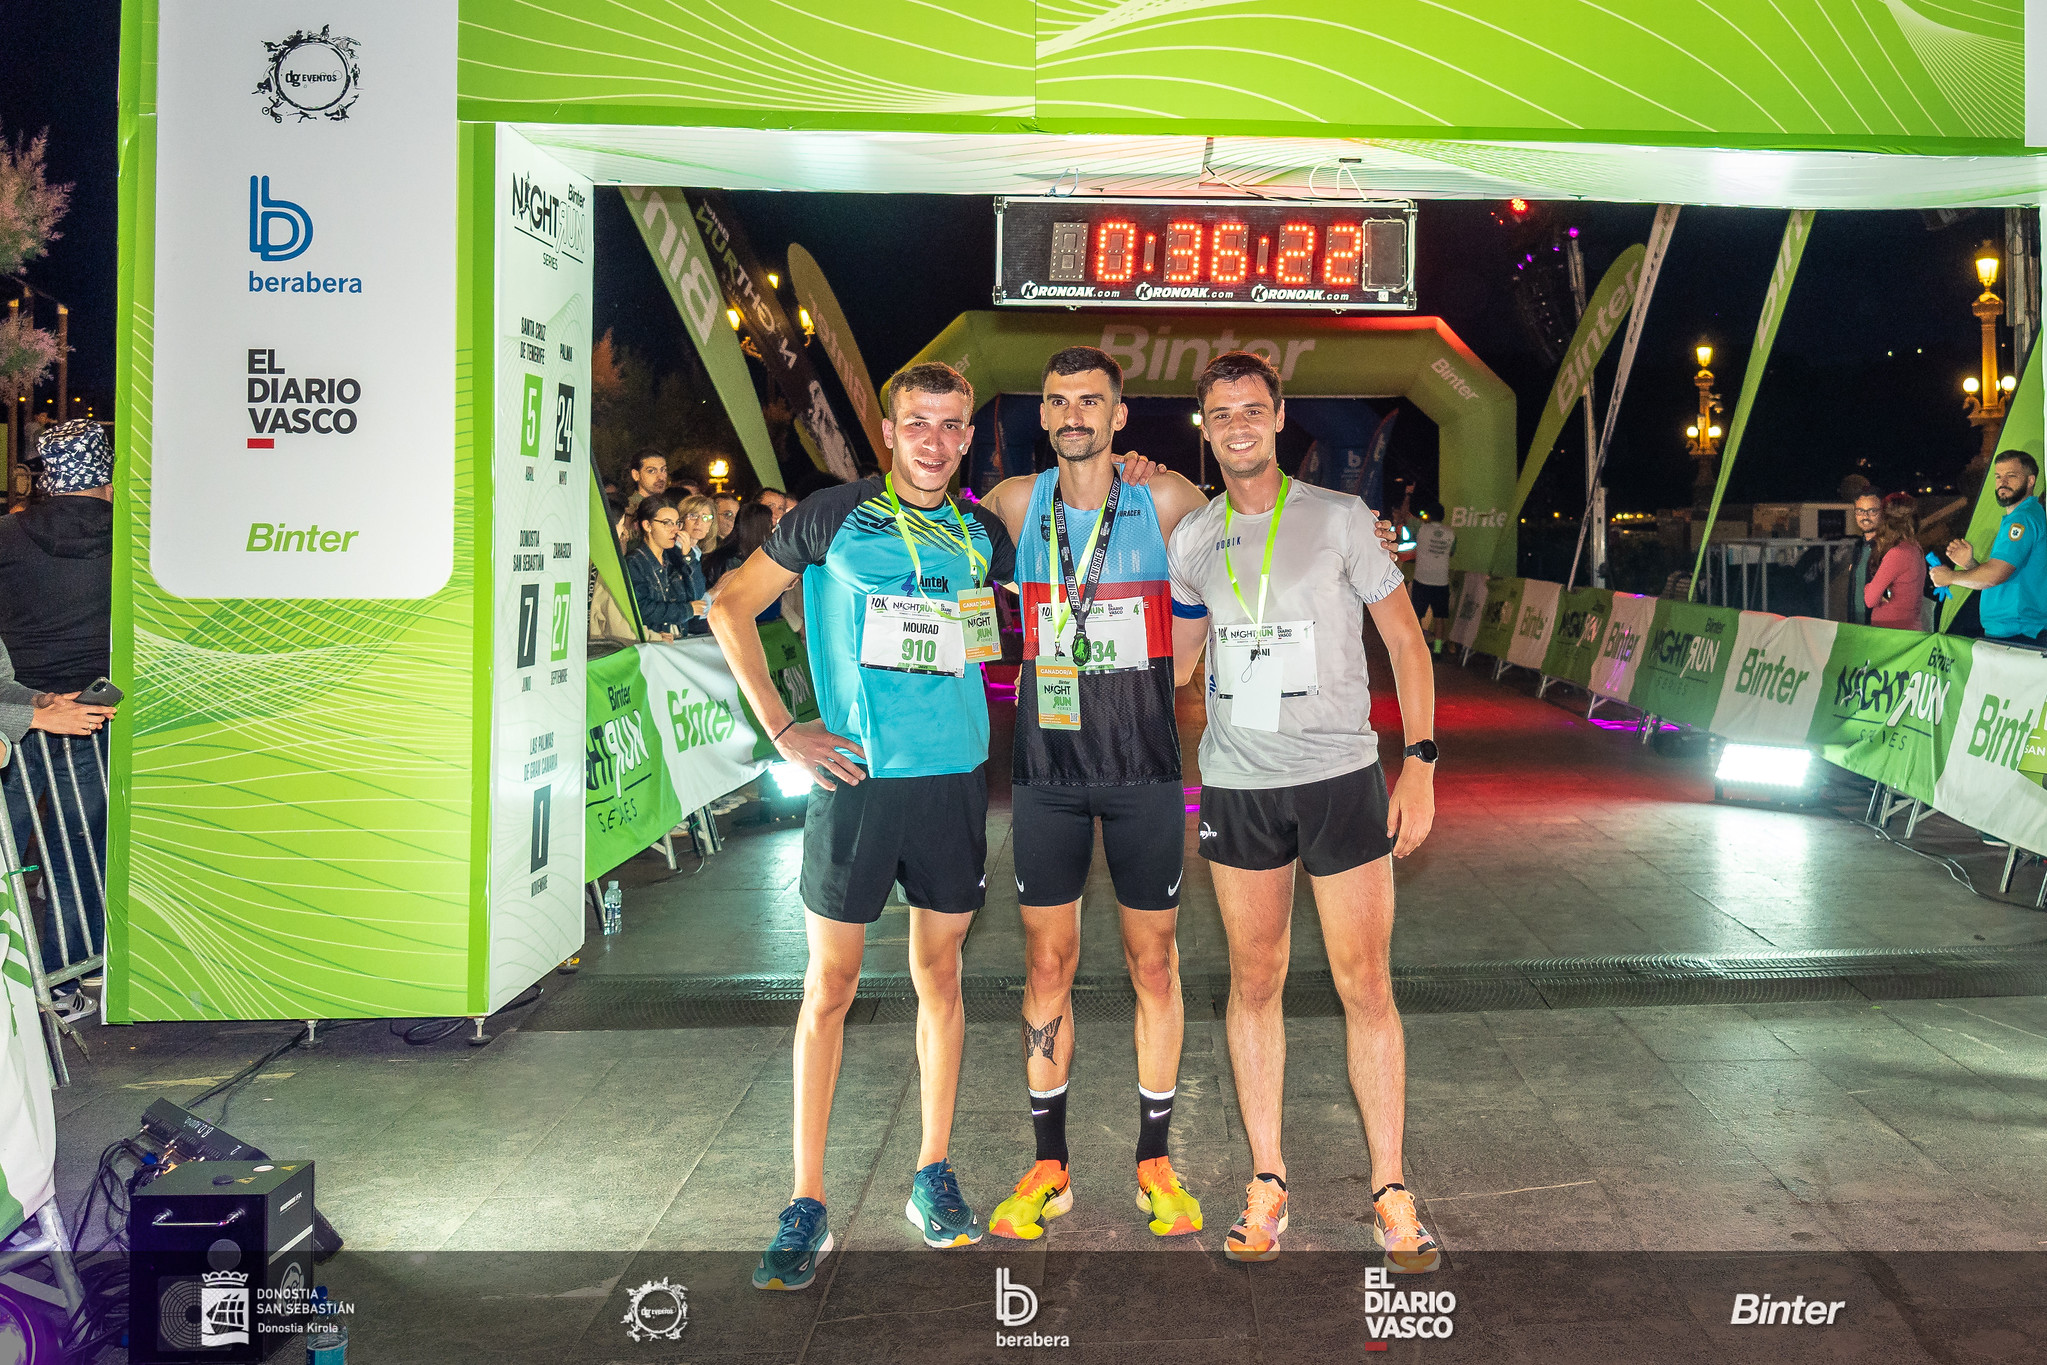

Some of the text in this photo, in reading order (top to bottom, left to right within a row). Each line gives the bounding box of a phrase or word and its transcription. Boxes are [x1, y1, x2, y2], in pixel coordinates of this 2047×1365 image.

[302, 74, 337, 82] EVENTOS
[568, 183, 586, 209] Binter
[543, 252, 559, 271] SERIES
[248, 271, 363, 293] berabera
[1020, 281, 1121, 300] KRONOAK.com
[1135, 281, 1235, 302] KRONOAK.com
[1250, 283, 1350, 304] KRONOAK.com
[535, 322, 547, 342] CRUZ
[1556, 260, 1641, 416] Binter
[247, 349, 285, 374] EL
[520, 341, 526, 358] DE
[560, 343, 573, 362] PALMA
[247, 378, 362, 404] DIARIO
[248, 408, 358, 435] VASCO
[526, 387, 538, 447] 5
[556, 395, 573, 453] 24
[1054, 501, 1067, 535] FINISHER
[245, 523, 360, 552] Binter
[513, 554, 522, 572] SAN
[1088, 548, 1105, 583] FINISHER
[1066, 576, 1081, 610] FINISHER
[524, 596, 534, 657] 7
[553, 594, 570, 652] 27
[903, 622, 939, 635] MOURAD
[902, 638, 937, 663] 910
[1928, 646, 1956, 674] Binter
[1040, 668, 1073, 676] GANADOR/A
[1735, 647, 1810, 707] Binter
[607, 684, 632, 712] Binter
[1044, 684, 1071, 696] NIGHT
[1052, 696, 1072, 709] RUN
[667, 688, 736, 754] Binter
[1967, 693, 2034, 771] Bint
[538, 800, 544, 859] 1
